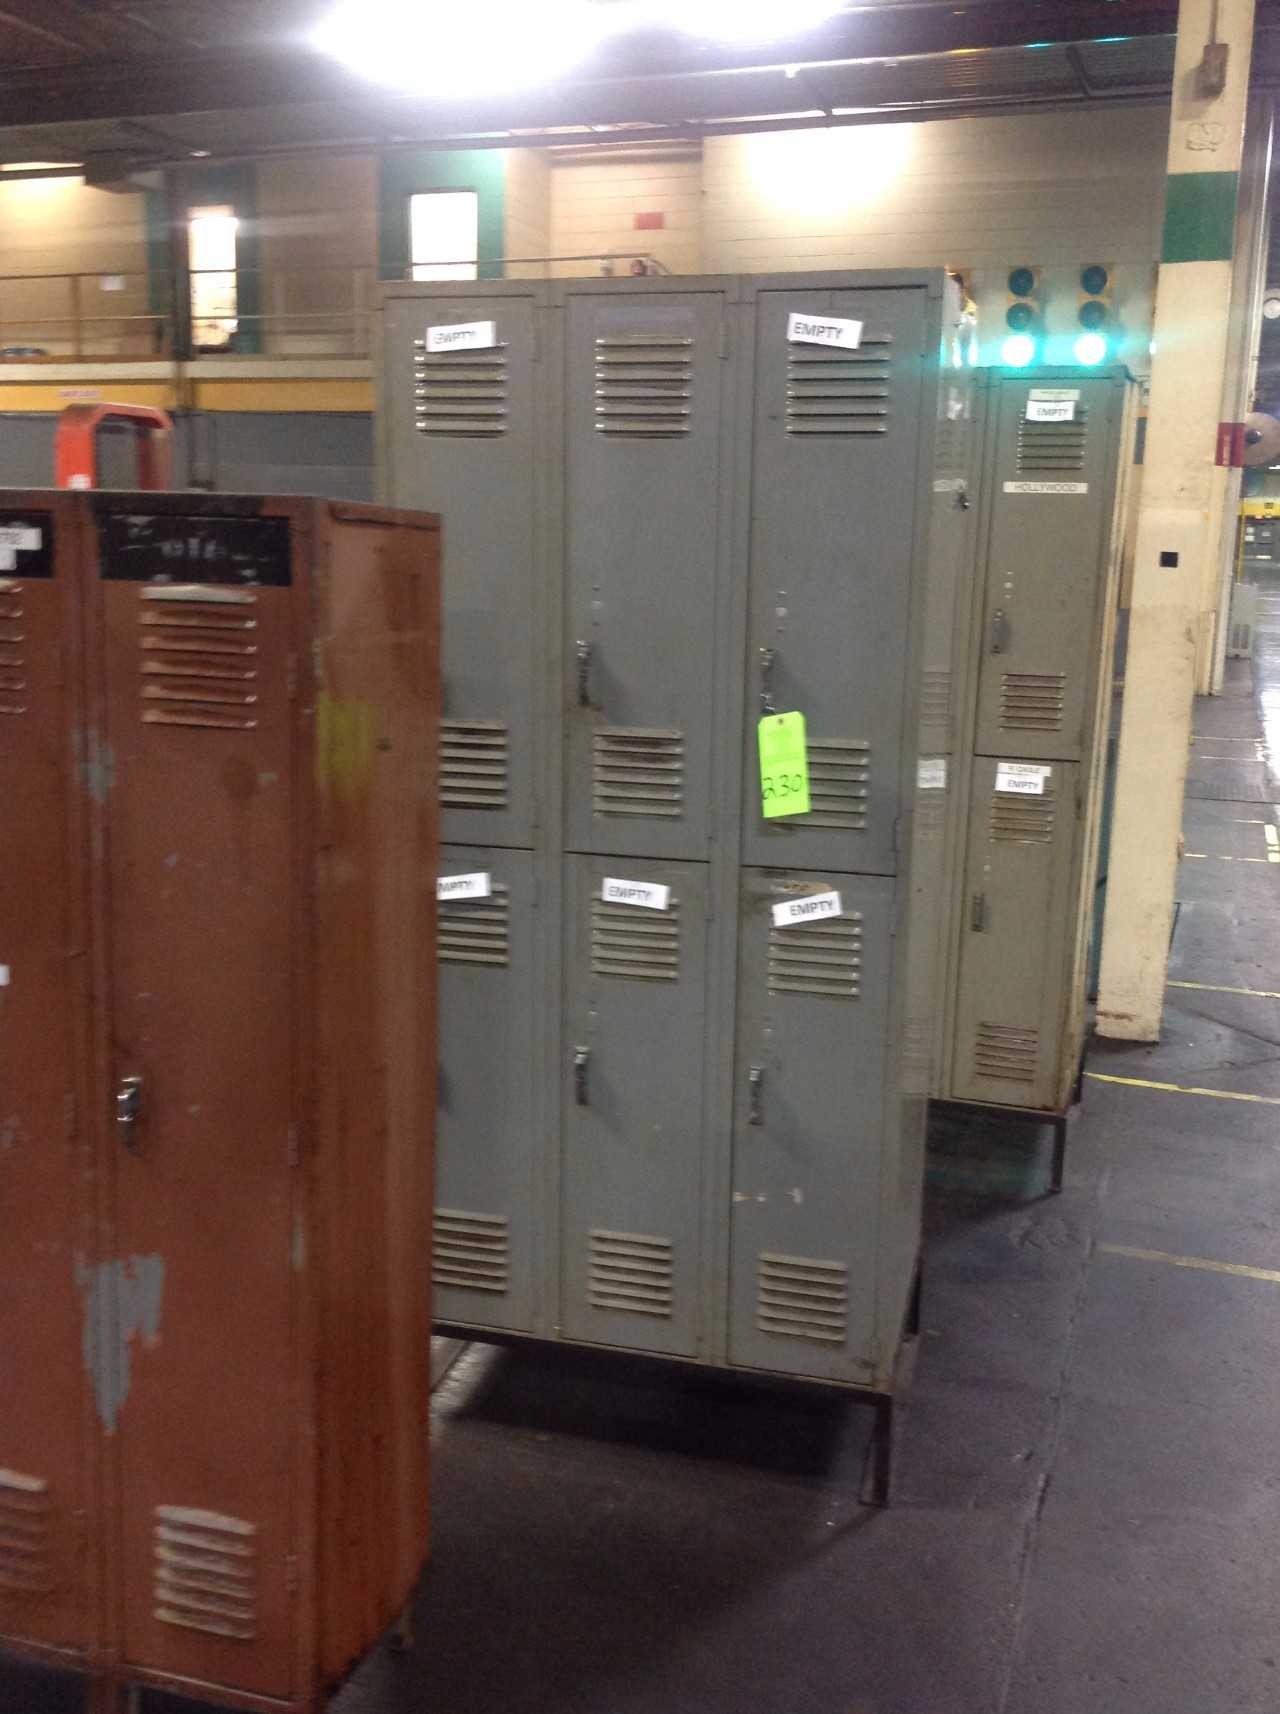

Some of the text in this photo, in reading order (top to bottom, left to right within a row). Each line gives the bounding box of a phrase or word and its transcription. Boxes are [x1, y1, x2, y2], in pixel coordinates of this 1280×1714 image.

[794, 321, 843, 339] EMPTY
[763, 774, 803, 800] 230
[608, 886, 652, 900] EMPTY
[789, 900, 833, 916] EMPTY
